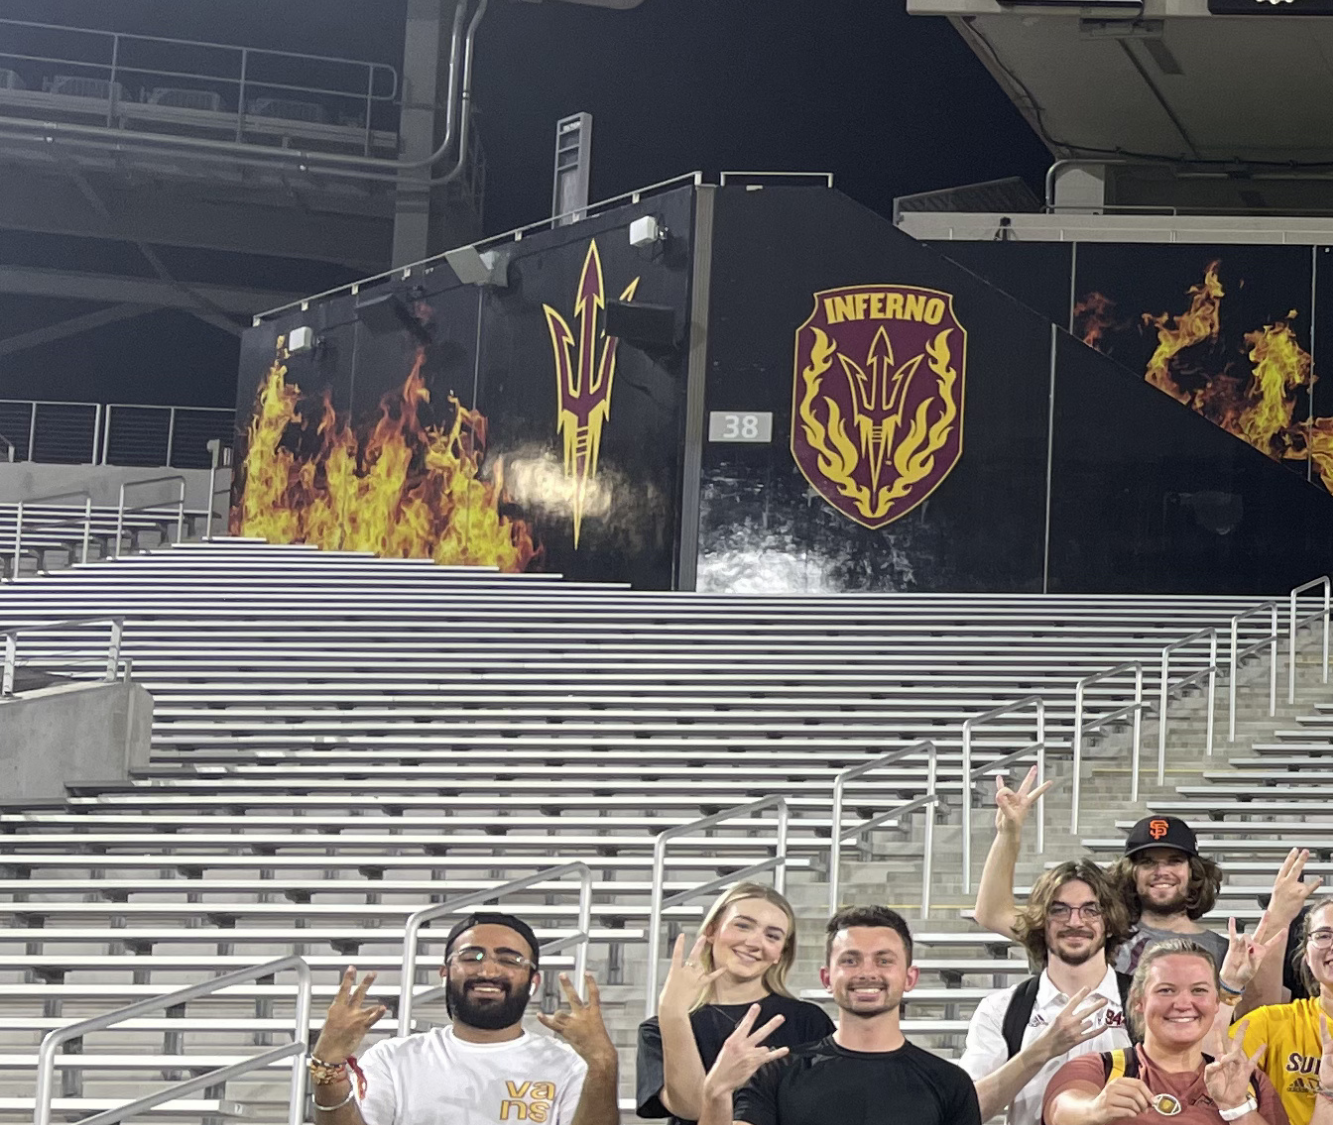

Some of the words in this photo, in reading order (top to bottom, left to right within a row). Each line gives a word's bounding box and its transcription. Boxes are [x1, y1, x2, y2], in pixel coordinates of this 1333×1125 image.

[824, 292, 946, 326] INFERNO
[722, 414, 759, 438] 38
[1105, 1009, 1127, 1026] 94
[505, 1080, 556, 1101] va
[500, 1100, 550, 1123] ns
